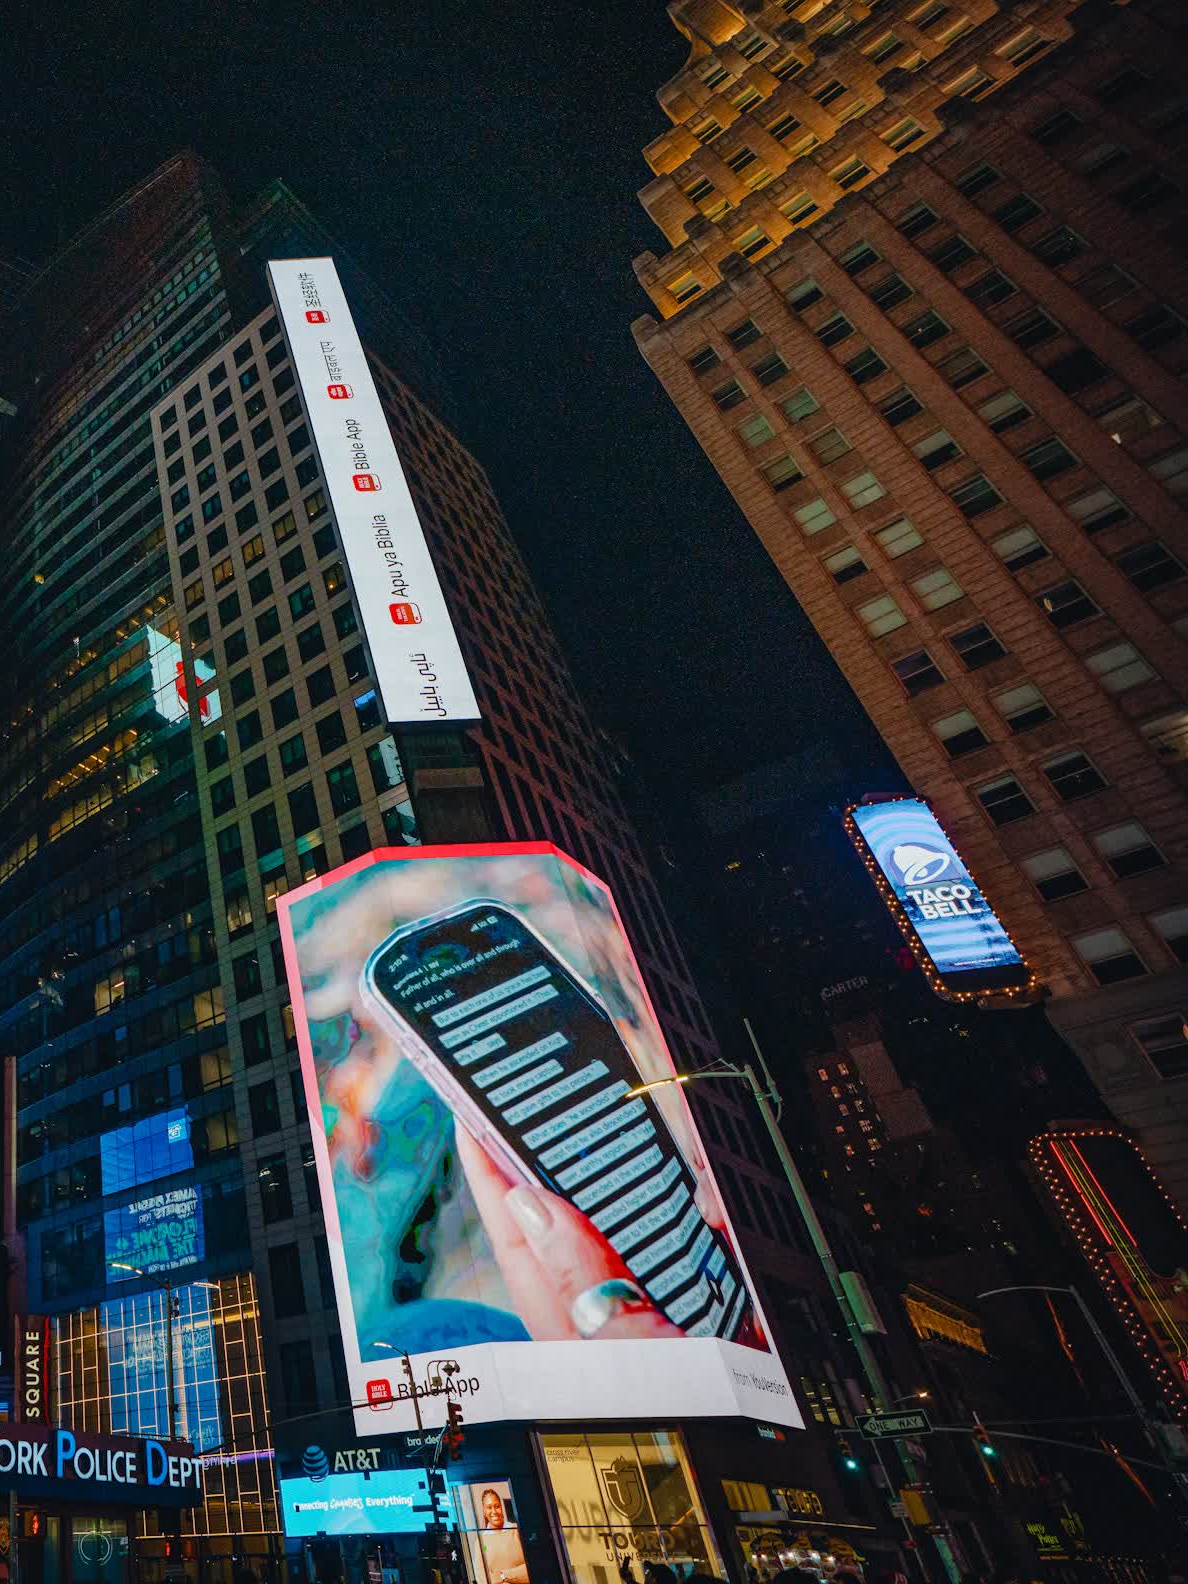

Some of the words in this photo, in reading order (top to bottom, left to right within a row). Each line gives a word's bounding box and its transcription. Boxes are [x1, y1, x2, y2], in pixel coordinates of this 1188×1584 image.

[345, 418, 363, 440] App
[353, 442, 370, 471] Bible
[372, 514, 393, 549] Biblia
[384, 552, 403, 569] ya
[391, 574, 409, 598] Apu
[906, 884, 971, 905] TACO
[919, 899, 982, 919] BELL
[400, 982, 423, 998] Father
[422, 977, 430, 986] of
[440, 967, 455, 978] who
[461, 959, 475, 969] over
[475, 953, 484, 962] all
[484, 948, 497, 959] and
[495, 939, 520, 953] through
[413, 1004, 424, 1013] all
[423, 997, 437, 1008] and
[443, 988, 455, 998] all.
[26, 1331, 40, 1418] SQUARE
[446, 1377, 480, 1397] App
[869, 1421, 890, 1432] ONE
[897, 1417, 920, 1429] WAY
[334, 1448, 380, 1472] AT&T
[366, 1496, 412, 1507] Everything
[598, 1532, 675, 1550] TOURO
